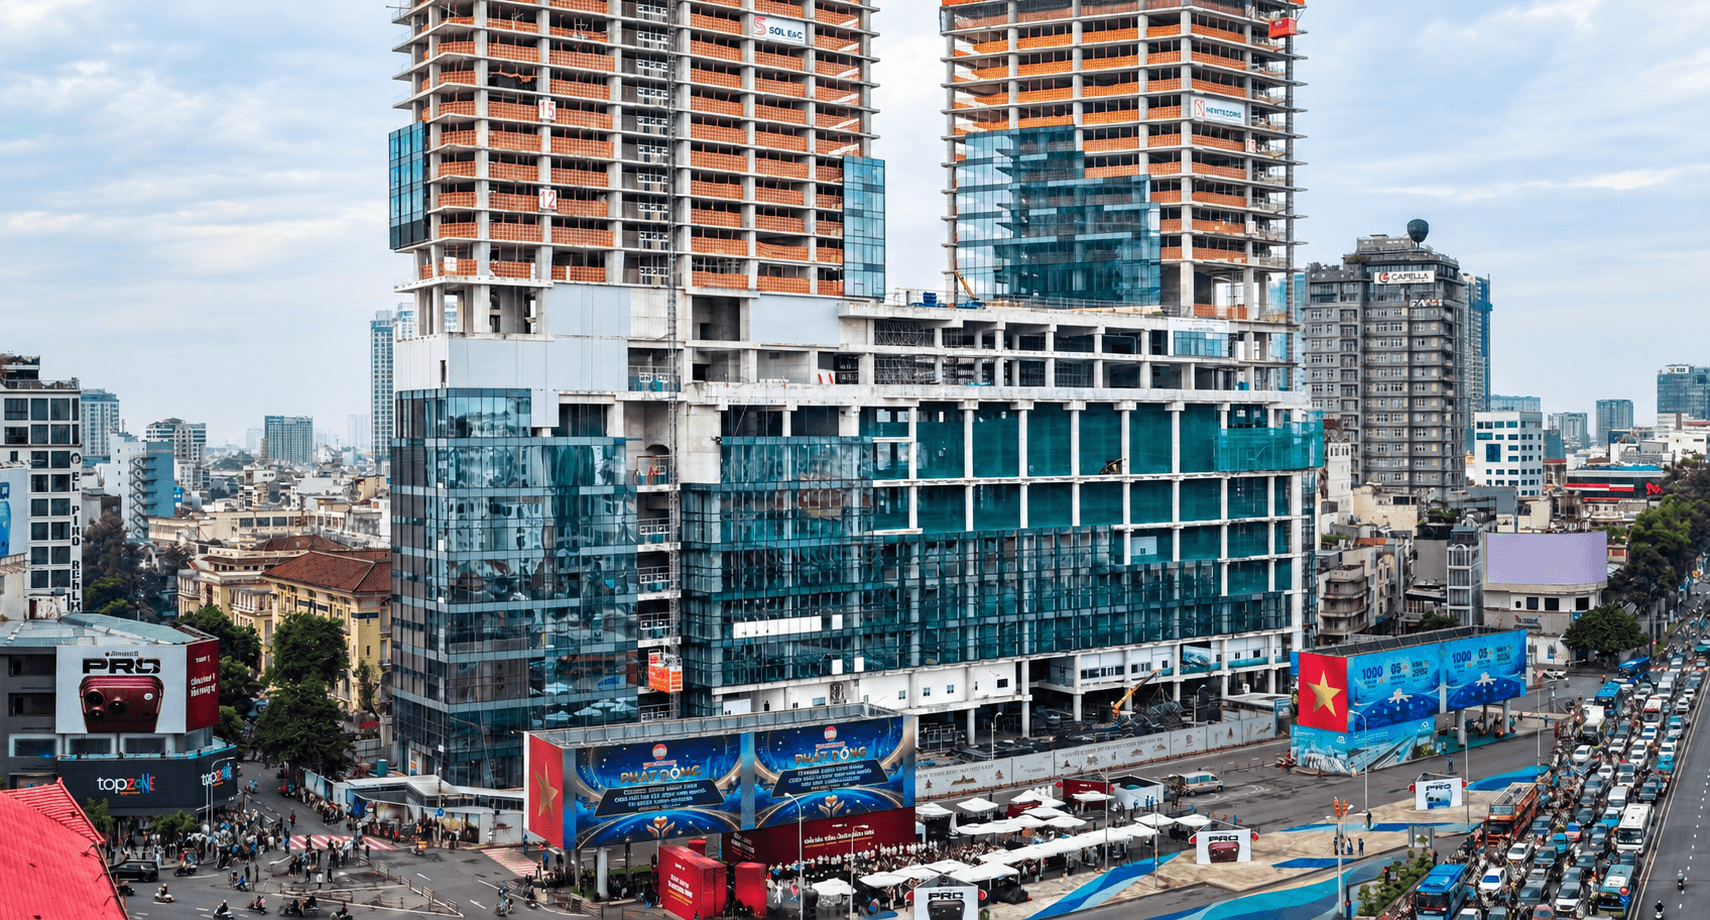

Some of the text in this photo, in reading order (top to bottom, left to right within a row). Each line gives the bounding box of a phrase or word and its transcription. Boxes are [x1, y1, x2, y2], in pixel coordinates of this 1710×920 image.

[769, 26, 786, 37] SOL
[541, 101, 555, 118] 15
[541, 190, 556, 209] 12
[1452, 650, 1472, 664] 1000
[83, 658, 161, 674] PRO
[1362, 665, 1383, 680] 1000
[1390, 662, 1402, 674] 05
